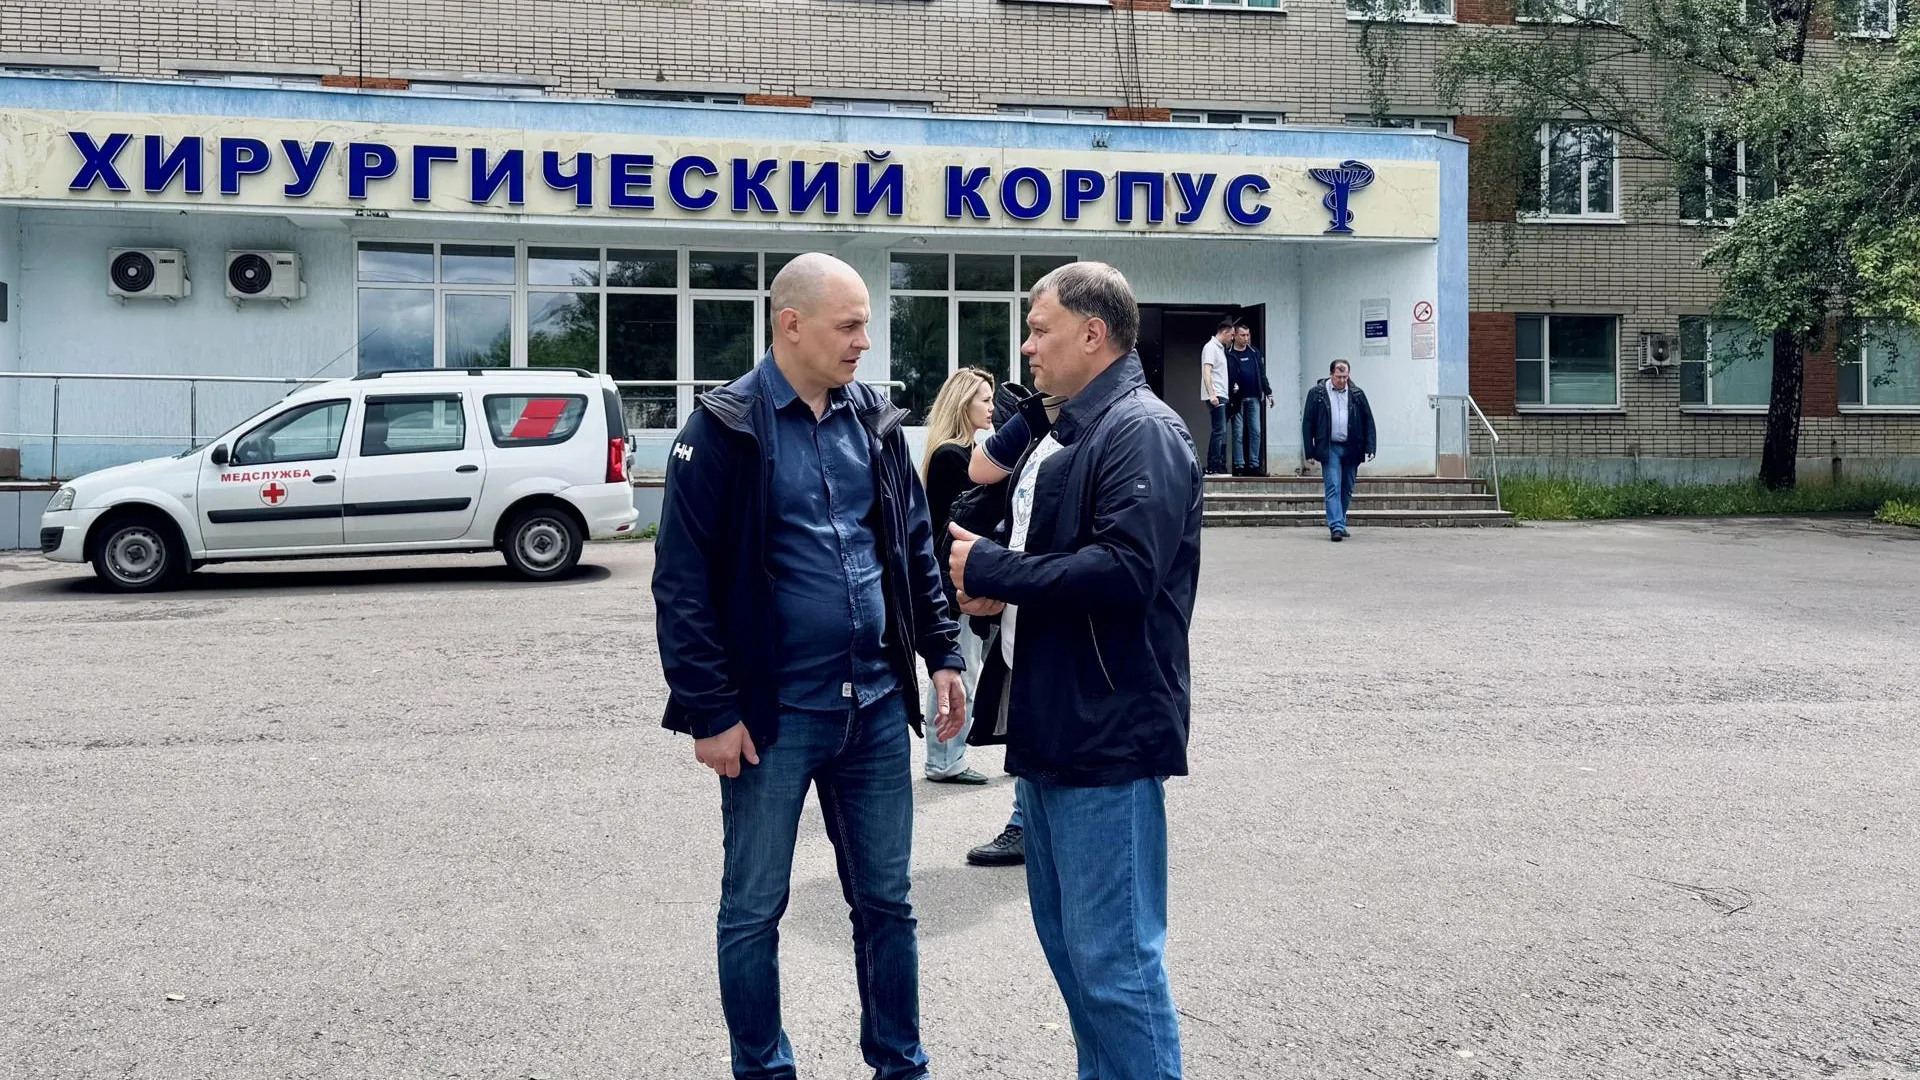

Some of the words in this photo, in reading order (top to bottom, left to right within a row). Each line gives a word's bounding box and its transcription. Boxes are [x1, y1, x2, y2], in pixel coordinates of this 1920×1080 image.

[67, 131, 905, 217] ХИРУРГИЧЕСКИЙ
[945, 164, 1273, 226] КОРПУС
[221, 469, 312, 482] МЕДСЛУЖБА
